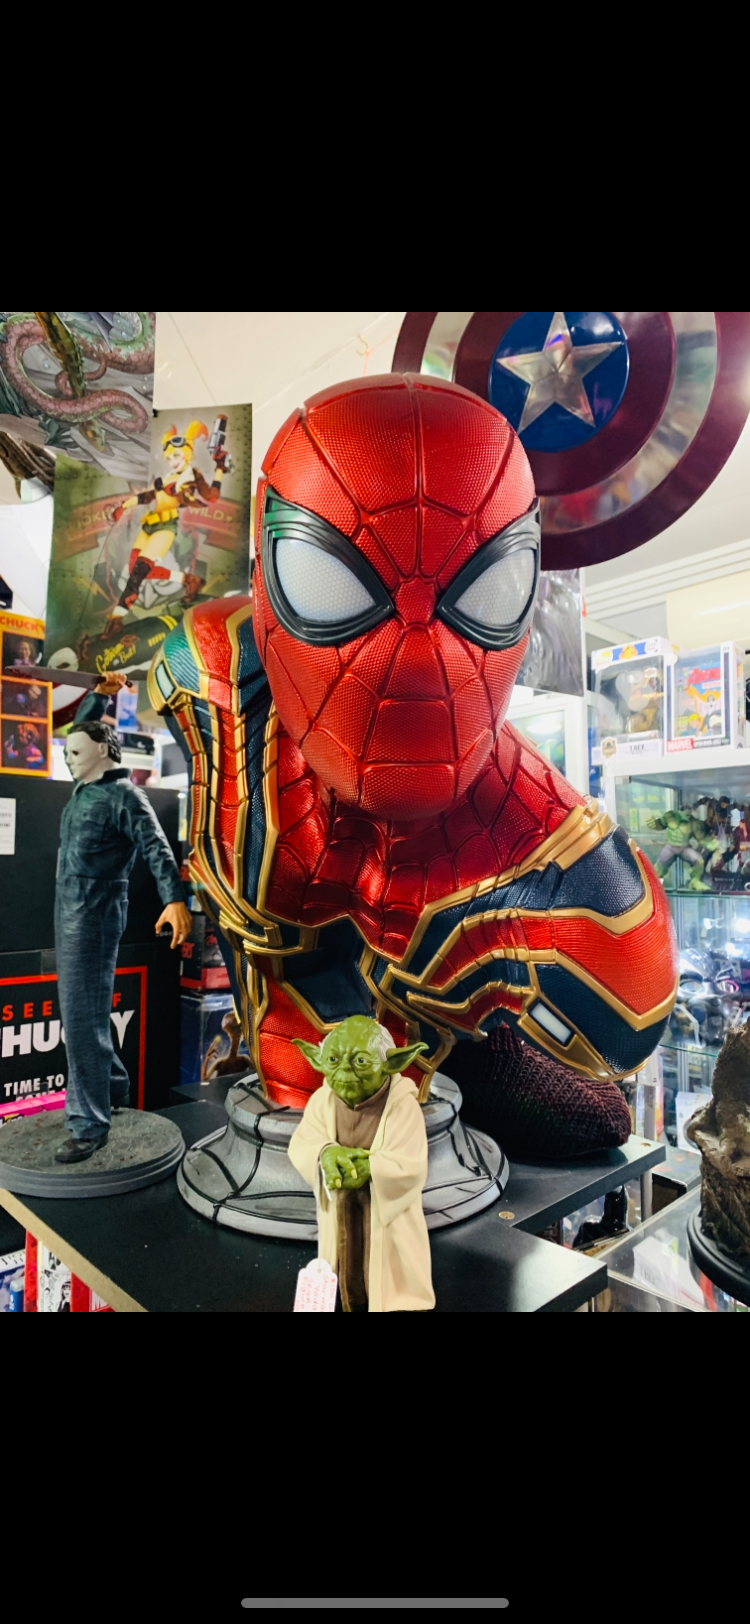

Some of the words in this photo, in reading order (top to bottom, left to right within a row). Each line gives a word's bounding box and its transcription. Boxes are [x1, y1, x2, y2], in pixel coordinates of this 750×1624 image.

[2, 1000, 53, 1022] SEE
[111, 992, 122, 1008] F
[4, 1077, 41, 1097] TIME
[46, 1073, 65, 1089] TO
